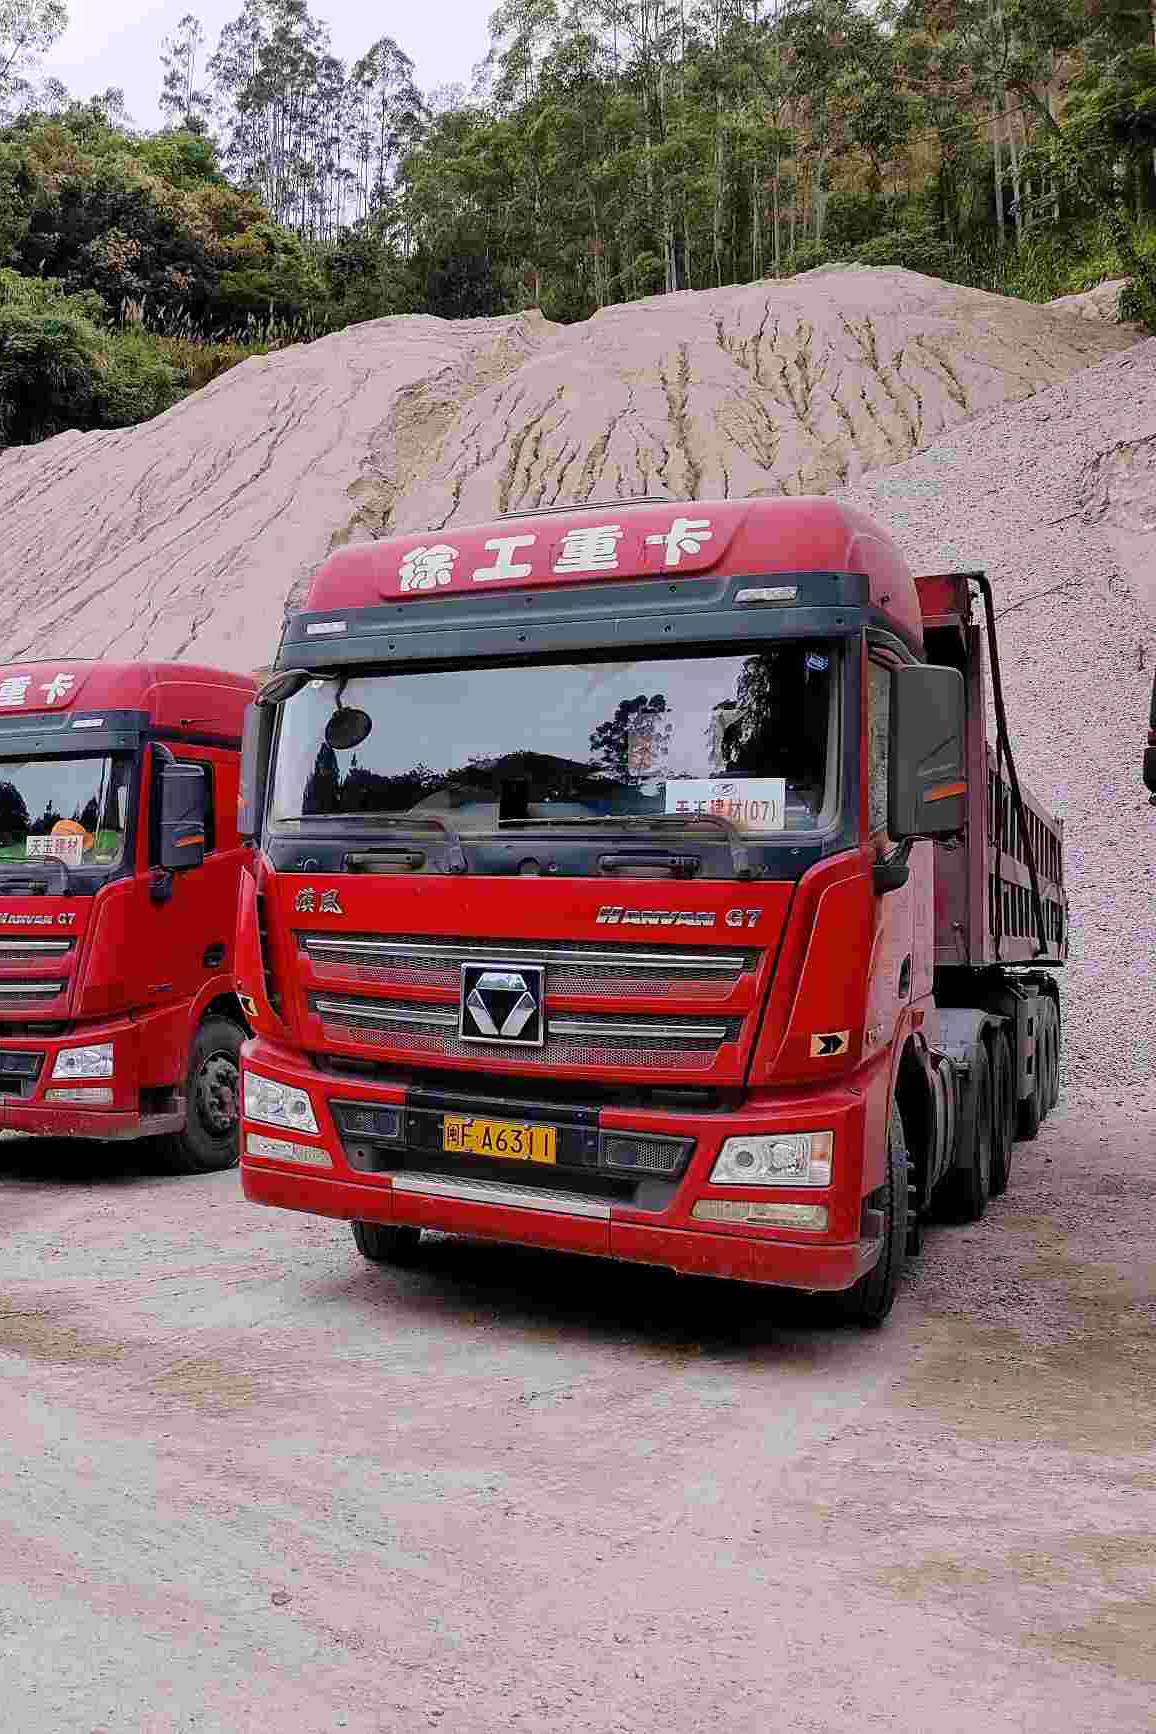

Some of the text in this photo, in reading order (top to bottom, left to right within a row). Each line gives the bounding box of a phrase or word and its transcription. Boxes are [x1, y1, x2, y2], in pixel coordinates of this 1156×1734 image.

[398, 518, 714, 592] 徐工重卡
[725, 908, 764, 928] G7
